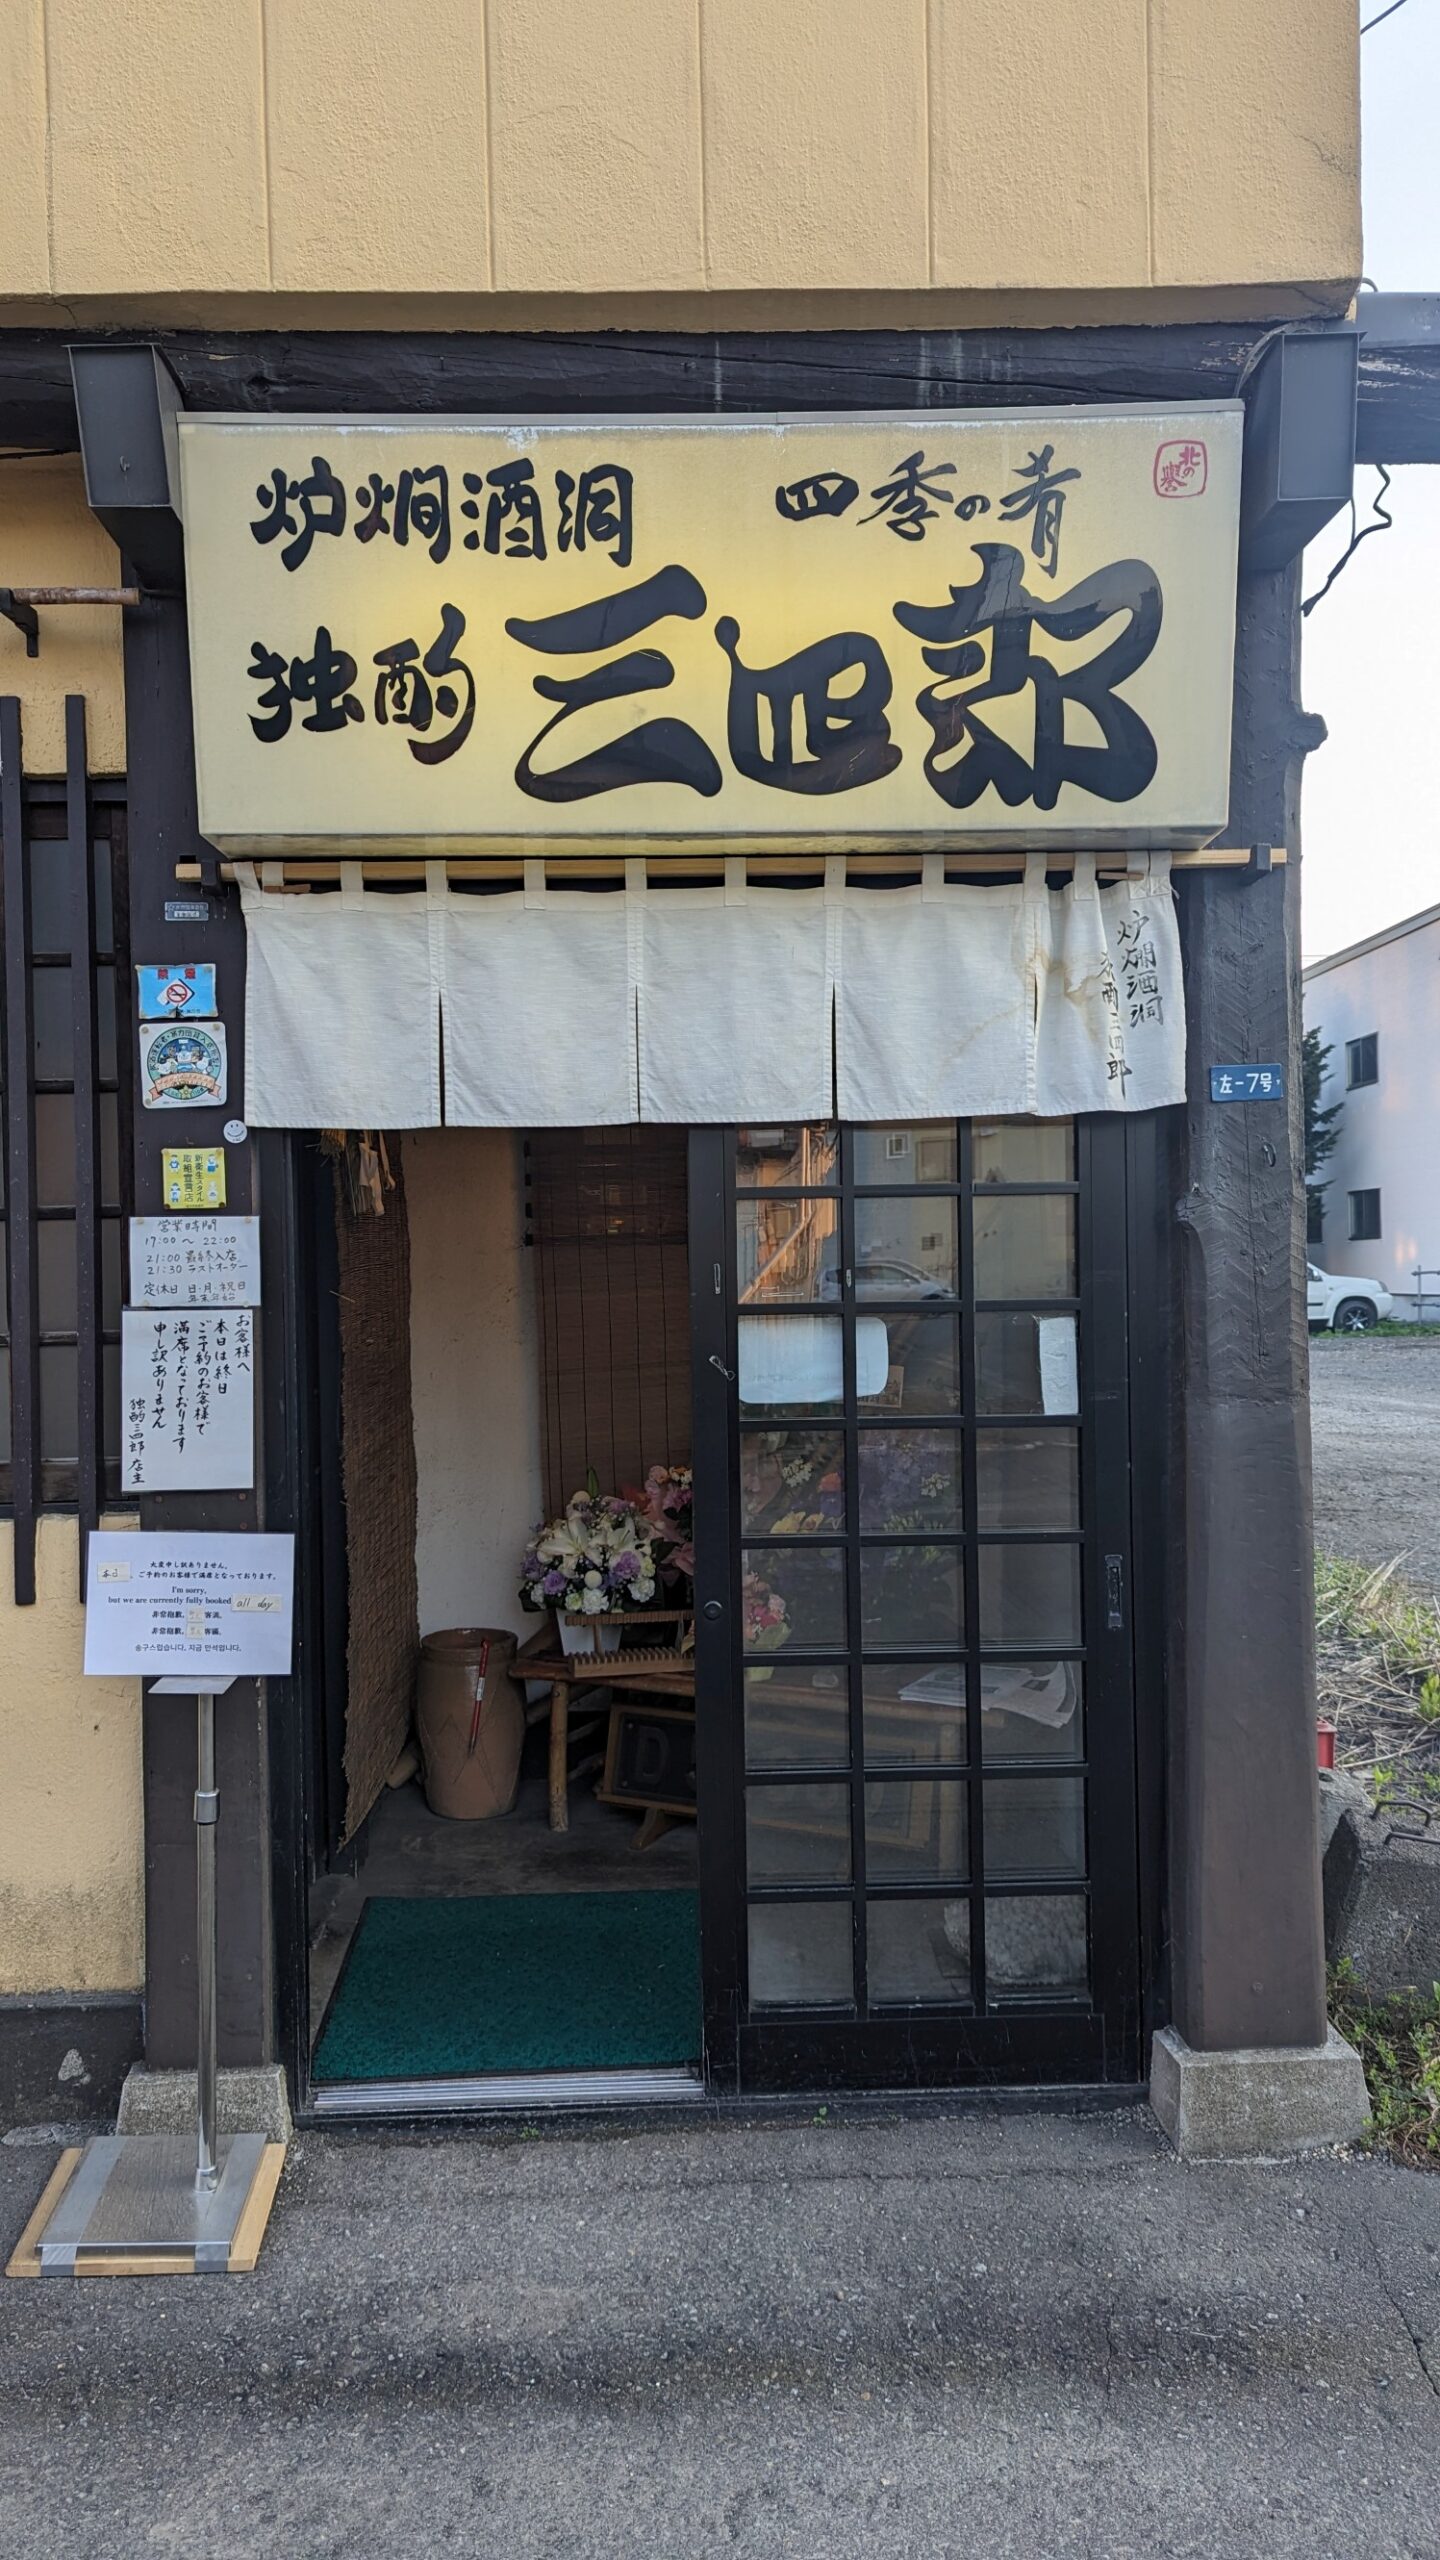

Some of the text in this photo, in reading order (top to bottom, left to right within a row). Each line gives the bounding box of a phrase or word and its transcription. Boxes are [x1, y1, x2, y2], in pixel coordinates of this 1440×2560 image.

[775, 445, 1081, 578] 四季の肴
[158, 1218, 217, 1233] 営業時間
[145, 1236, 177, 1248] 17:00
[203, 1236, 237, 1246] 22:00
[146, 1253, 180, 1263] 21:00
[147, 1265, 182, 1275] 21:30
[144, 1282, 178, 1297] 定休日
[234, 1314, 251, 1372] お客様へ
[213, 1318, 232, 1395] 本日は終日
[151, 1321, 168, 1429] 申し訳ありません
[194, 1319, 213, 1436] ご予約のお客様で
[171, 1320, 190, 1454] 満席となっております
[127, 1397, 146, 1484] 独酌三四郎 店主
[171, 1585, 184, 1594] I'm
[108, 1596, 121, 1604] but
[149, 1596, 184, 1605] currently
[185, 1596, 203, 1605] fully
[205, 1597, 232, 1605] booked
[236, 1597, 250, 1608] all
[257, 1597, 274, 1611] day
[188, 1644, 203, 1652] 지금
